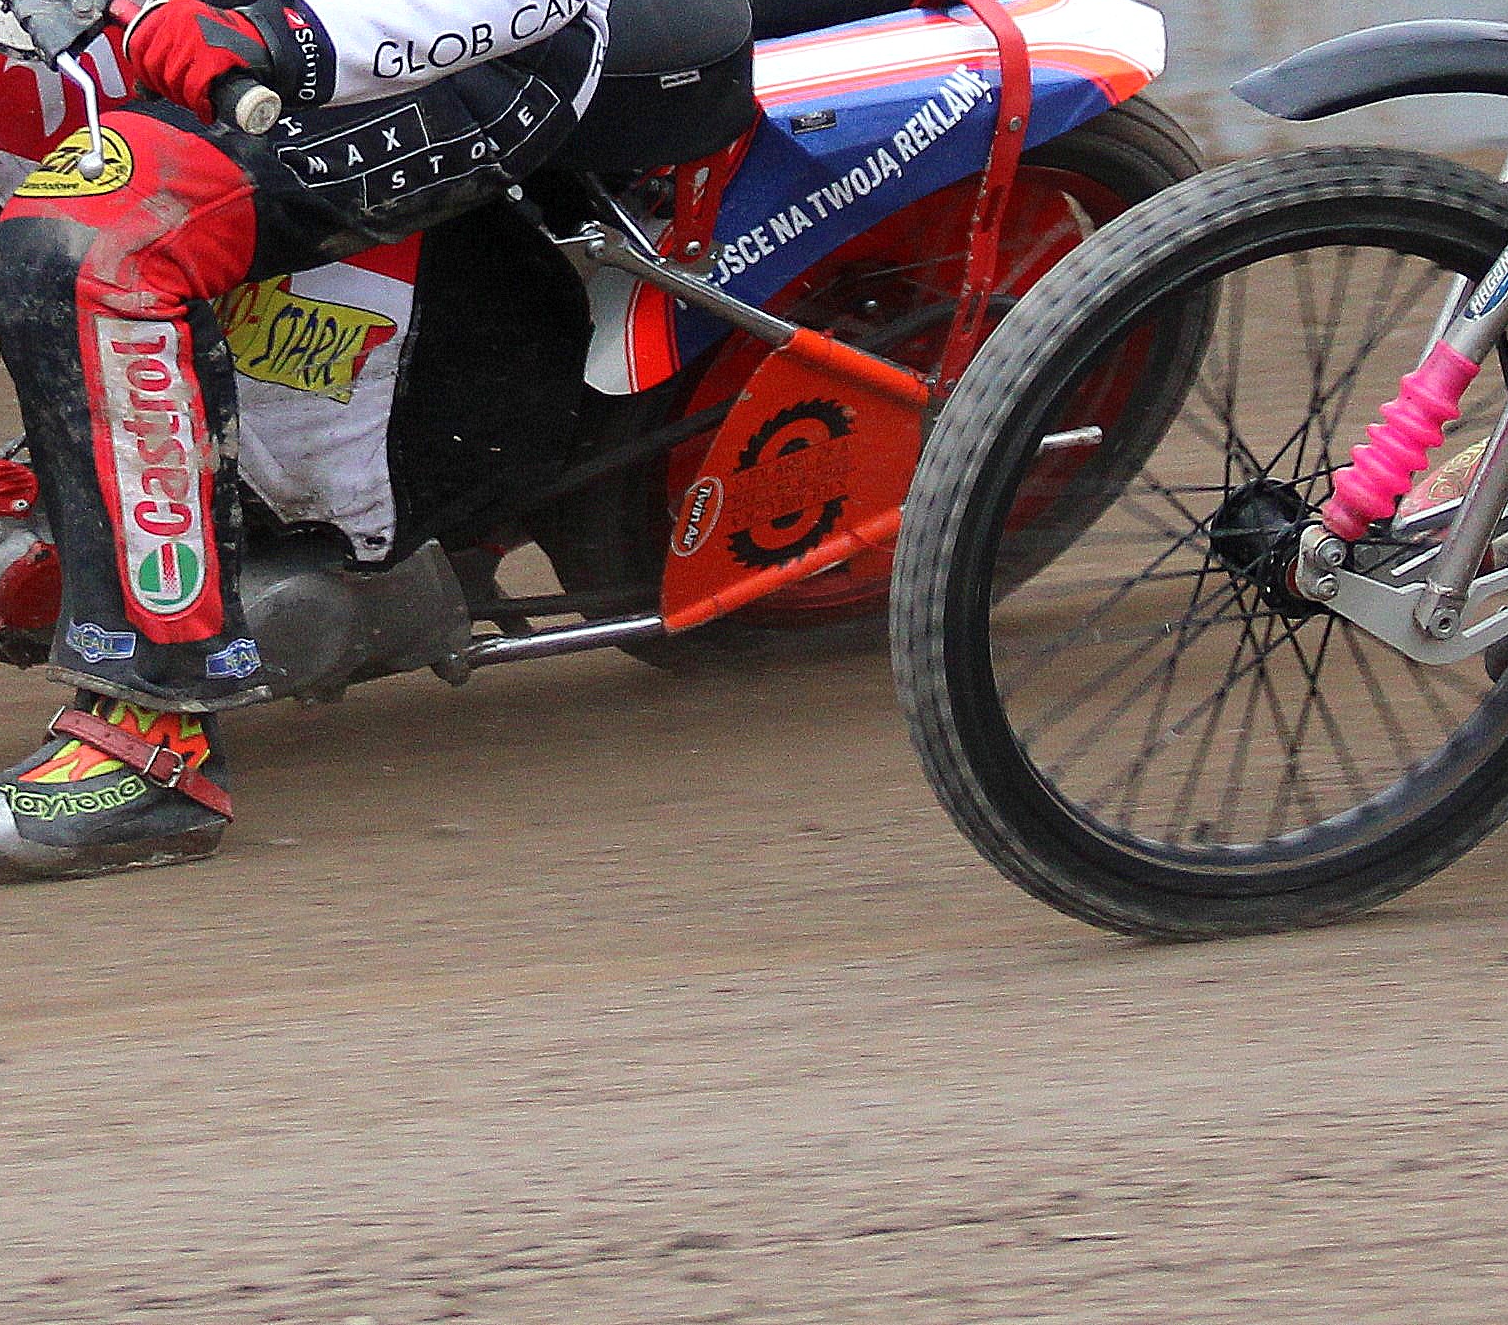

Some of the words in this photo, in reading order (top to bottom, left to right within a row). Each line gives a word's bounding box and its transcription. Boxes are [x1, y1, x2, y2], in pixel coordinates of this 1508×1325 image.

[373, 22, 494, 78] GLOB
[307, 126, 402, 175] MAX
[769, 205, 814, 245] NA
[806, 147, 903, 220] TWOJĄ
[893, 64, 993, 162] REKLAMĘ
[110, 336, 194, 538] Castrol
